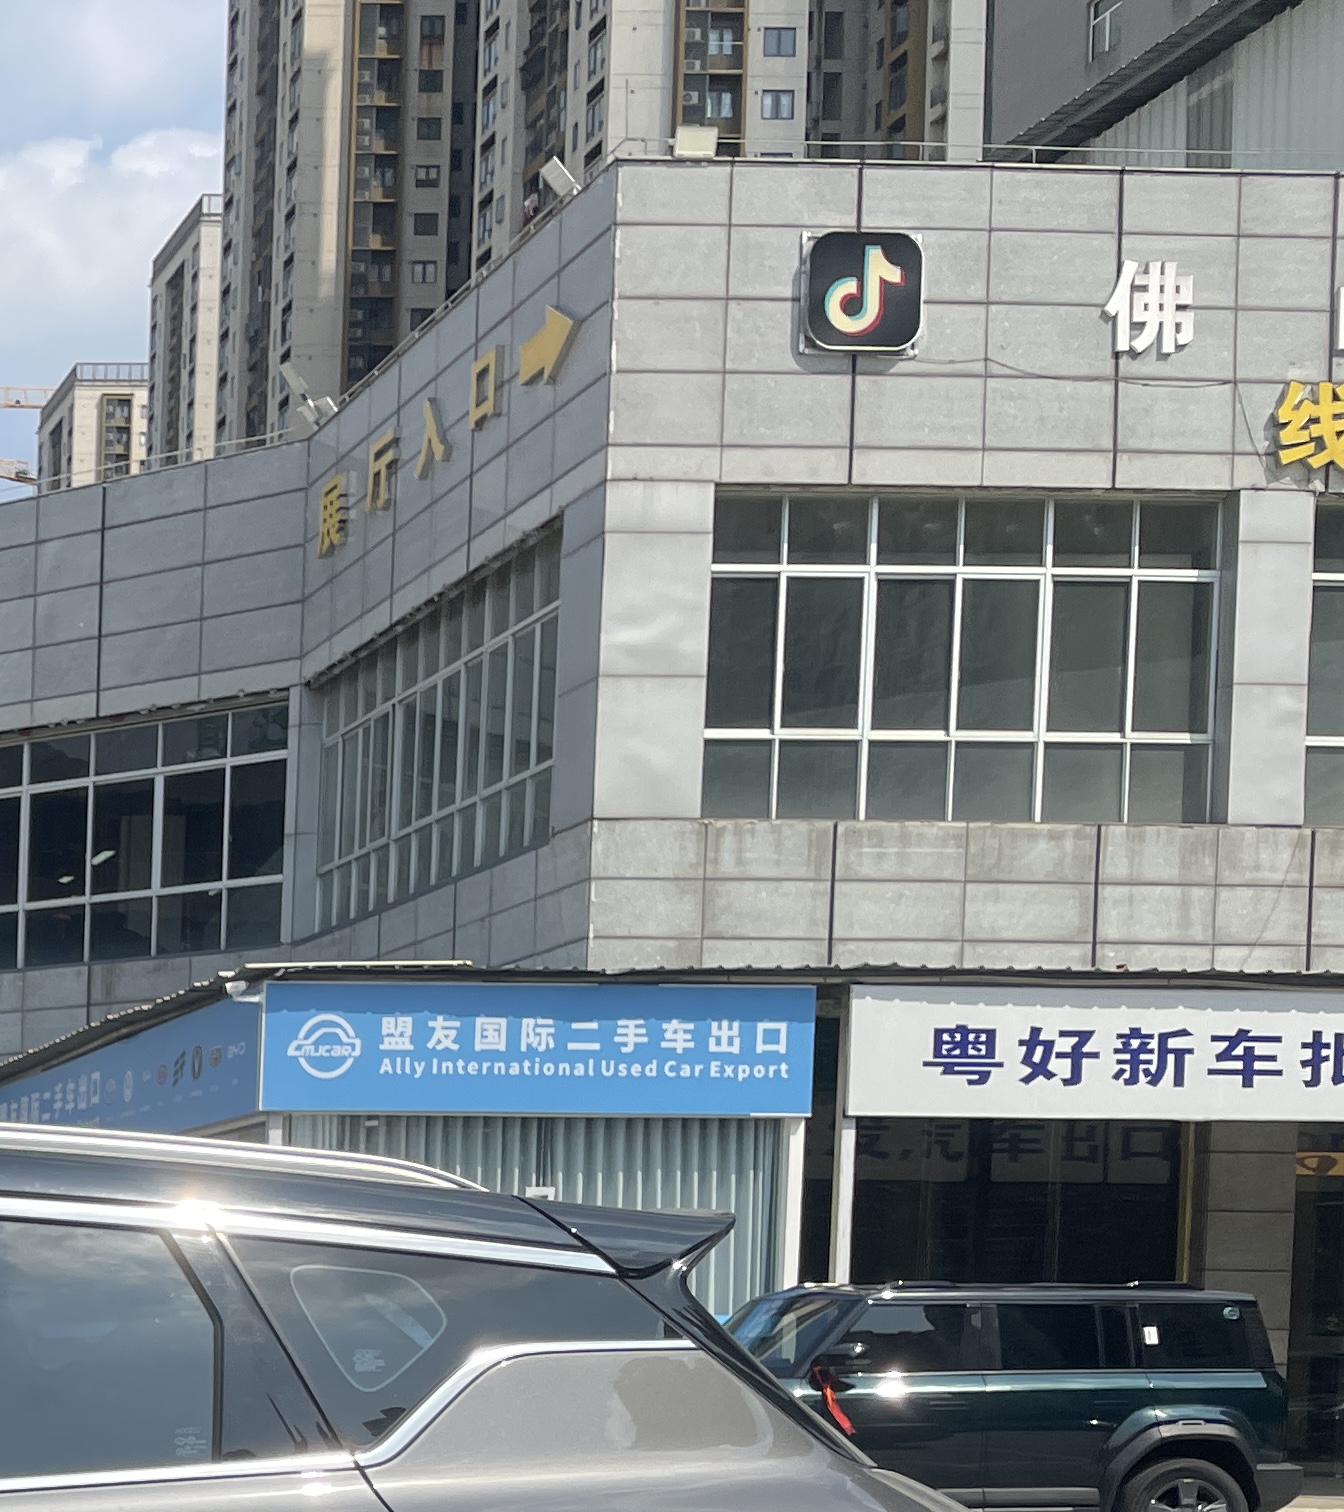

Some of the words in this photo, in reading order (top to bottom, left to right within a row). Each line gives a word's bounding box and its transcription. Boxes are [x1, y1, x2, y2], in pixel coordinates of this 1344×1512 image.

[1104, 259, 1195, 355] 佛
[318, 348, 497, 558] 展厅入口
[379, 1015, 788, 1054] 盟友国际二手车出口
[379, 1057, 426, 1079] Ally
[432, 1057, 594, 1077] International
[601, 1059, 657, 1077] Used
[663, 1060, 704, 1078] Car
[709, 1060, 789, 1082] Export
